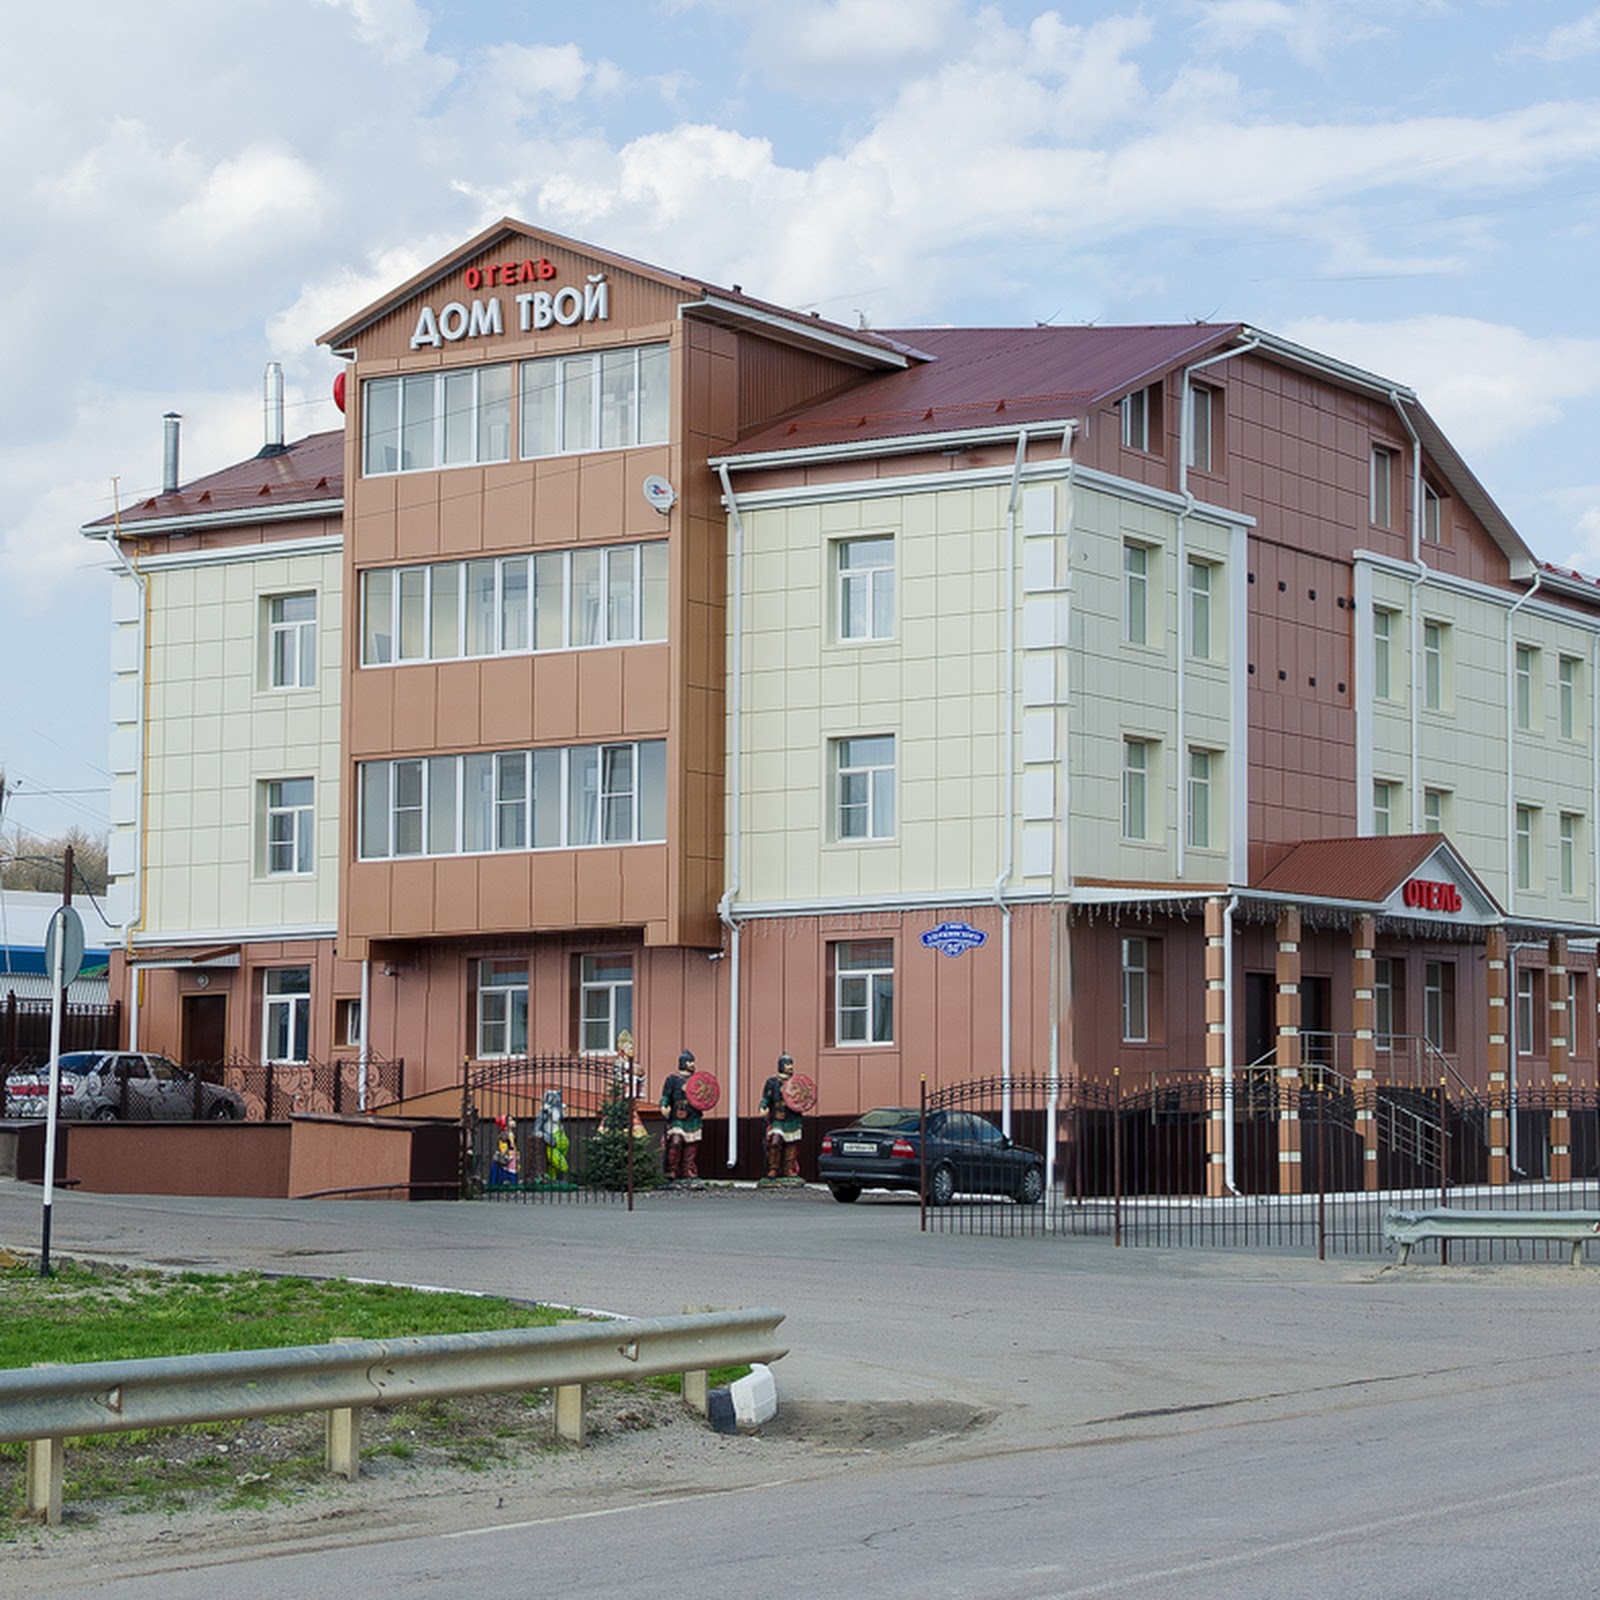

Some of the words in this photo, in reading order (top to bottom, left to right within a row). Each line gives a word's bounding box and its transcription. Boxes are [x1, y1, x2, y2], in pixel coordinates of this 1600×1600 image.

[464, 258, 556, 289] ОТЕЛЬ
[410, 297, 503, 350] ДОМ
[516, 273, 609, 332] ТВОЙ
[1403, 879, 1462, 912] ОТЕЛЬ
